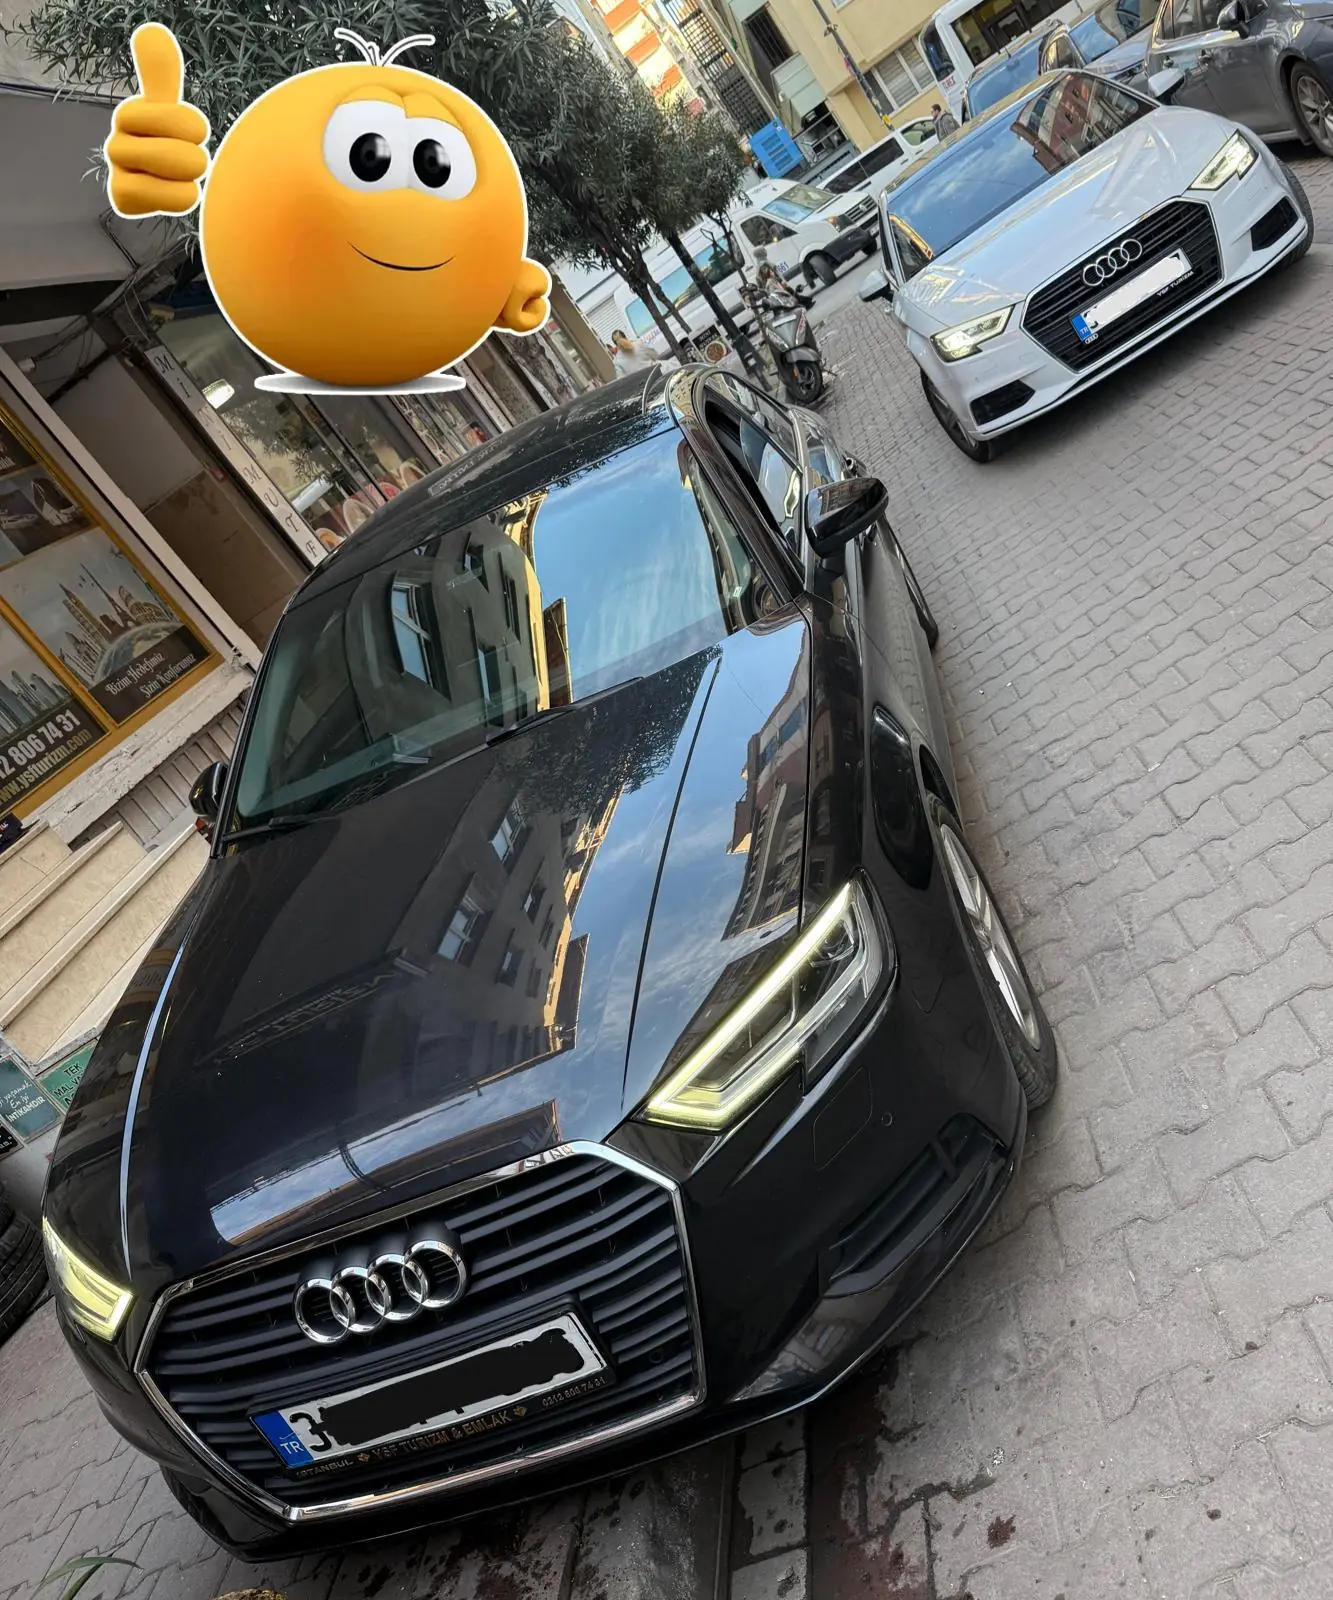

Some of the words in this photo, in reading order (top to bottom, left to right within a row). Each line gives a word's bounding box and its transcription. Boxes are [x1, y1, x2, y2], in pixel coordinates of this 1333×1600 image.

[243, 464, 320, 558] MUTF
[105, 674, 132, 695] Bizim
[127, 652, 165, 684] Hedefimiz
[140, 678, 162, 698] Sizin
[156, 653, 196, 683] Konforunuz
[8, 733, 46, 766] 806
[37, 721, 63, 745] 74
[56, 709, 81, 732] 31
[64, 1062, 83, 1077] TEK
[54, 1083, 74, 1098] MAL
[462, 1410, 513, 1436] EMLAK
[281, 1440, 304, 1455] TR
